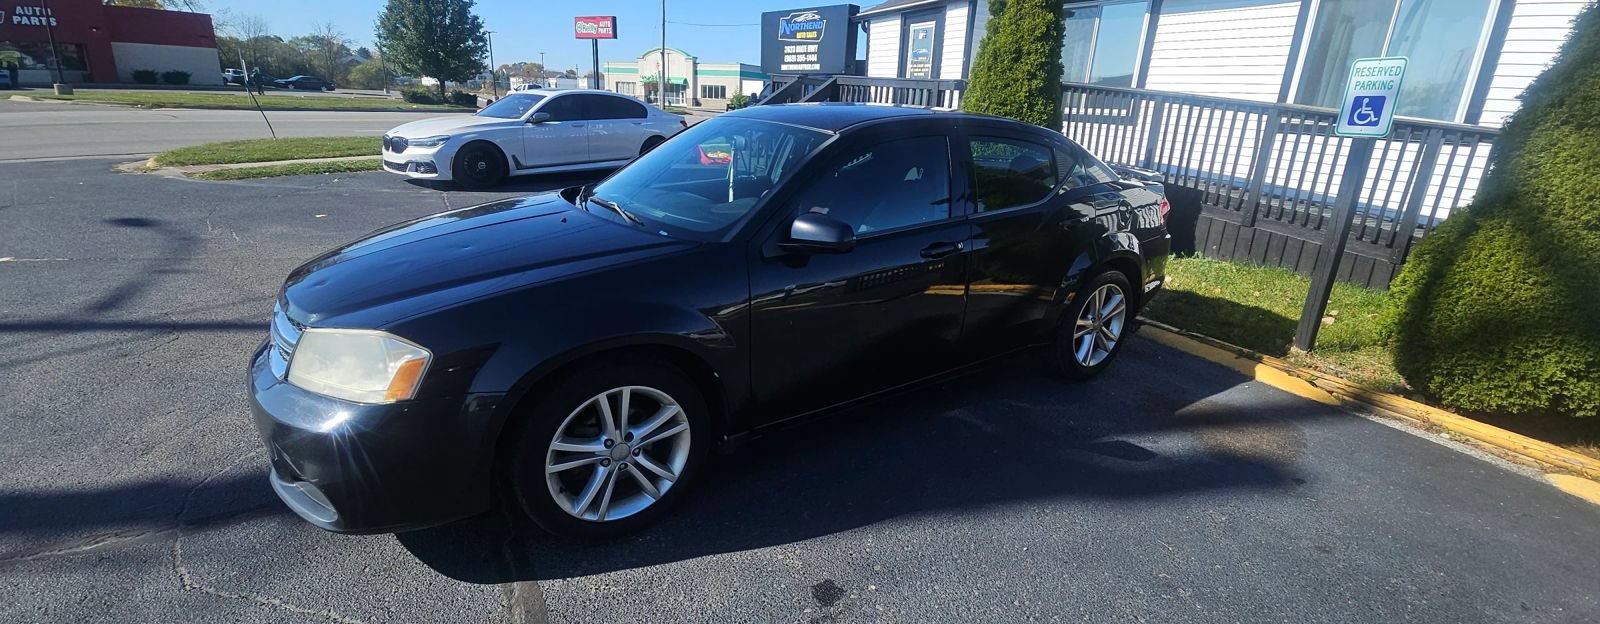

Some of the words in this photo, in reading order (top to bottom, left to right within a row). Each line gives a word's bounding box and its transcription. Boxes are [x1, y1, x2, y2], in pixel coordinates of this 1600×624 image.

[12, 16, 57, 26] PARTS
[781, 20, 823, 35] NORTHEND
[1354, 66, 1402, 77] RESERVED
[1354, 80, 1394, 90] PARKING
